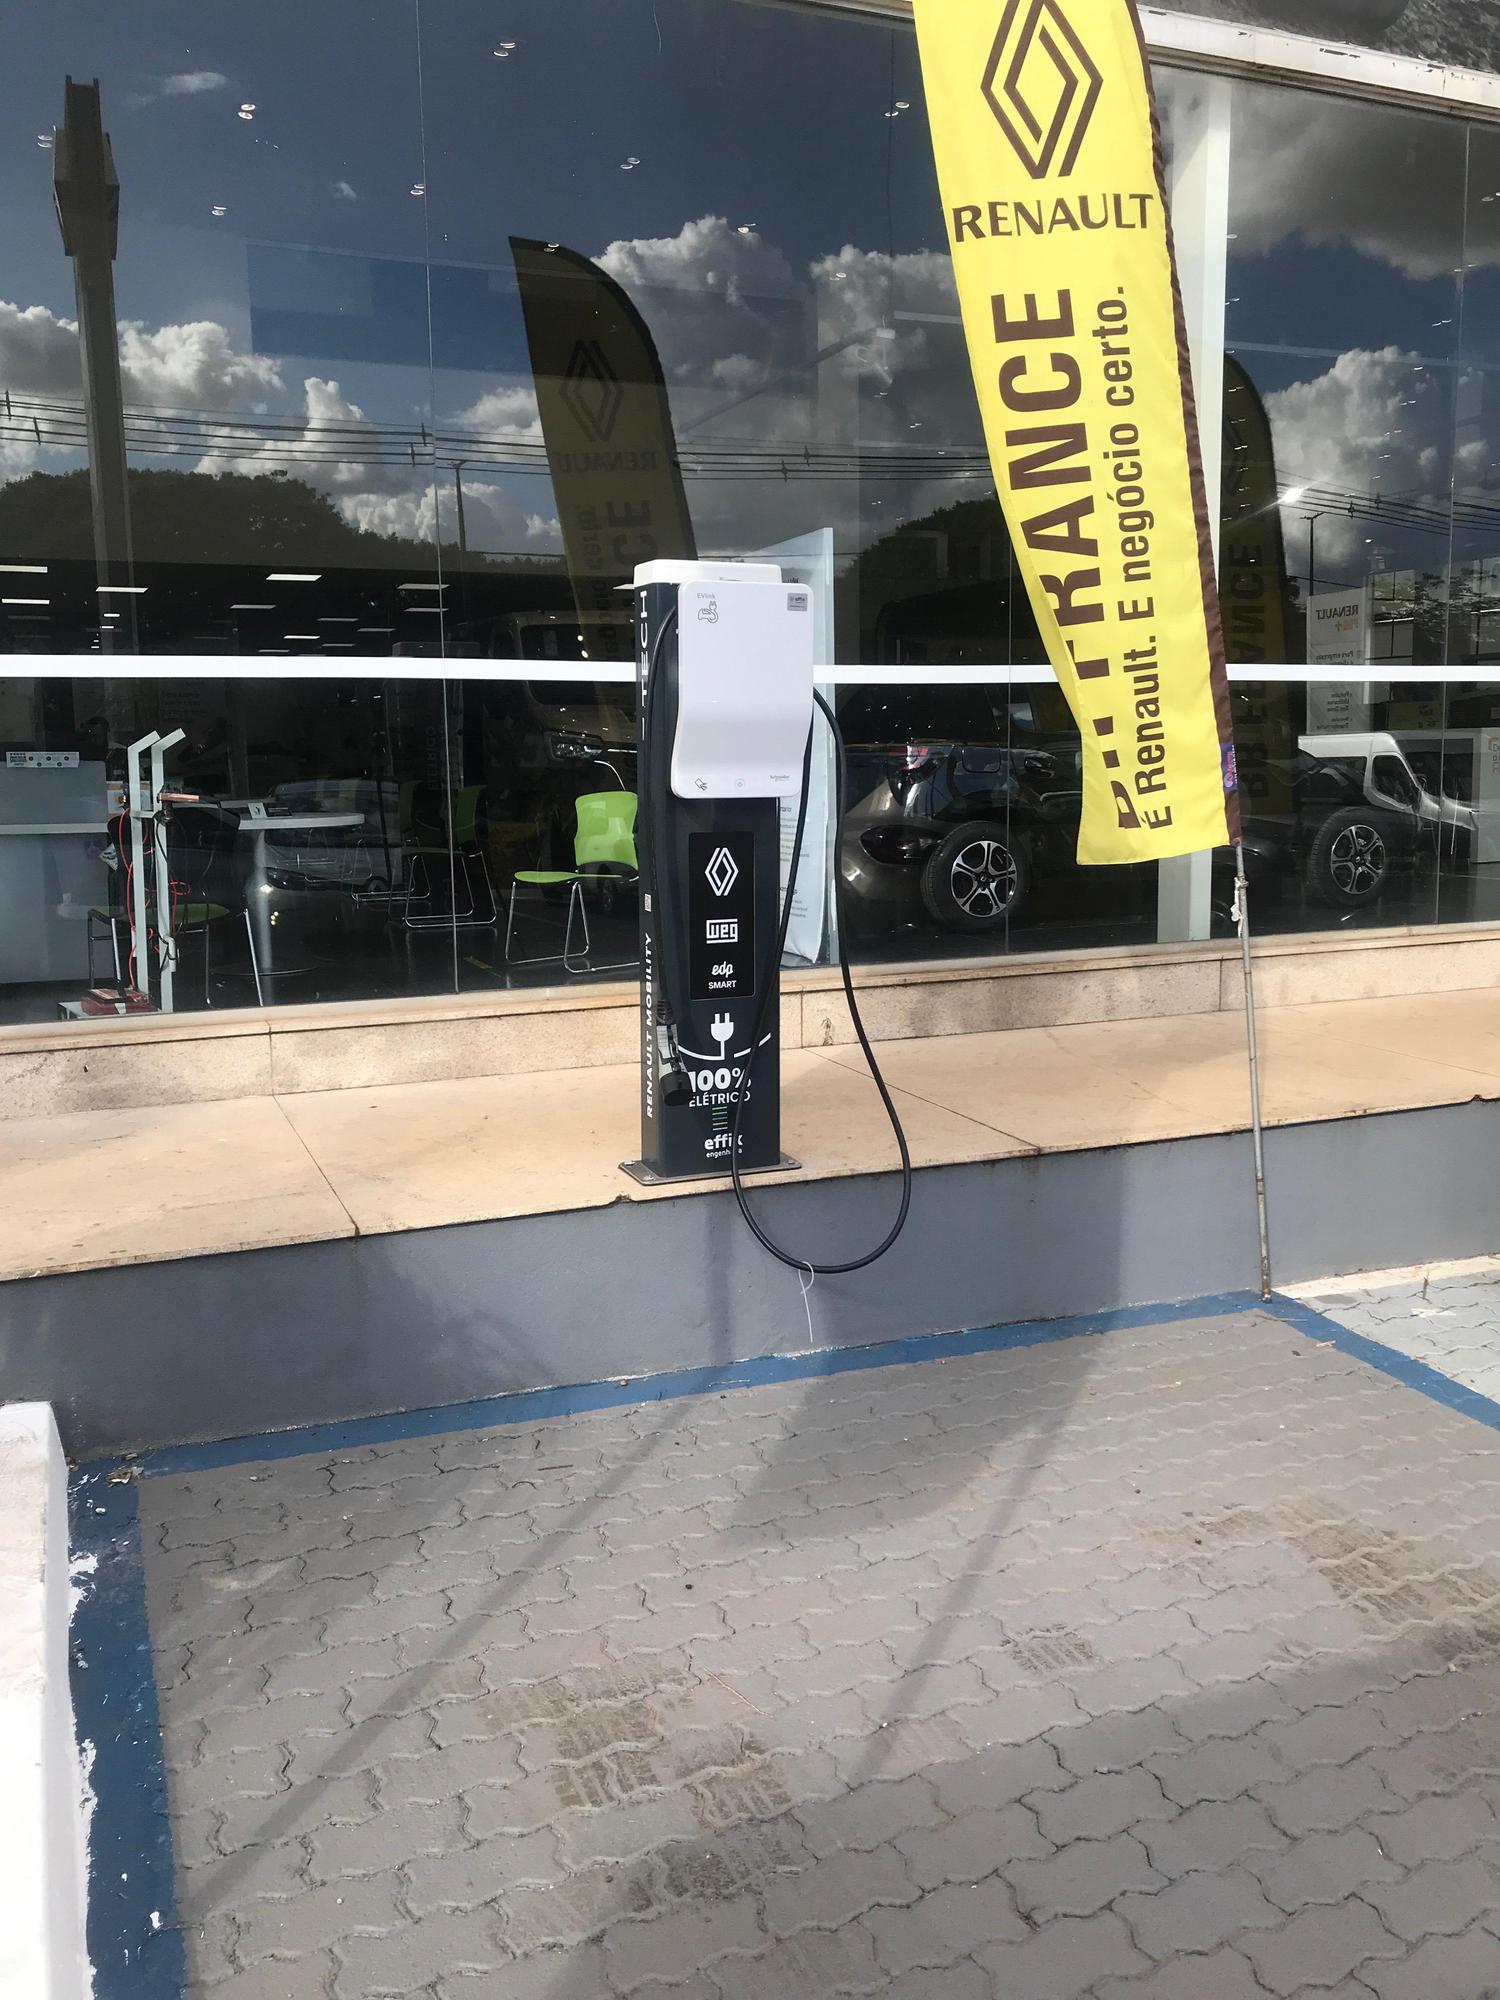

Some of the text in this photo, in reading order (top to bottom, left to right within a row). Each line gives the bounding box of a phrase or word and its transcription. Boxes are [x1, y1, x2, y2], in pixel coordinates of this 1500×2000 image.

[952, 193, 1154, 242] RENAULT
[1092, 286, 1134, 407] certo.
[1103, 423, 1155, 582] negócio
[1123, 636, 1167, 795] Renault.
[1141, 805, 1173, 830] É
[708, 980, 737, 990] SMART
[711, 961, 734, 978] edp
[644, 932, 654, 1119] RENAULT MOBILITY
[688, 1067, 752, 1093] 100%
